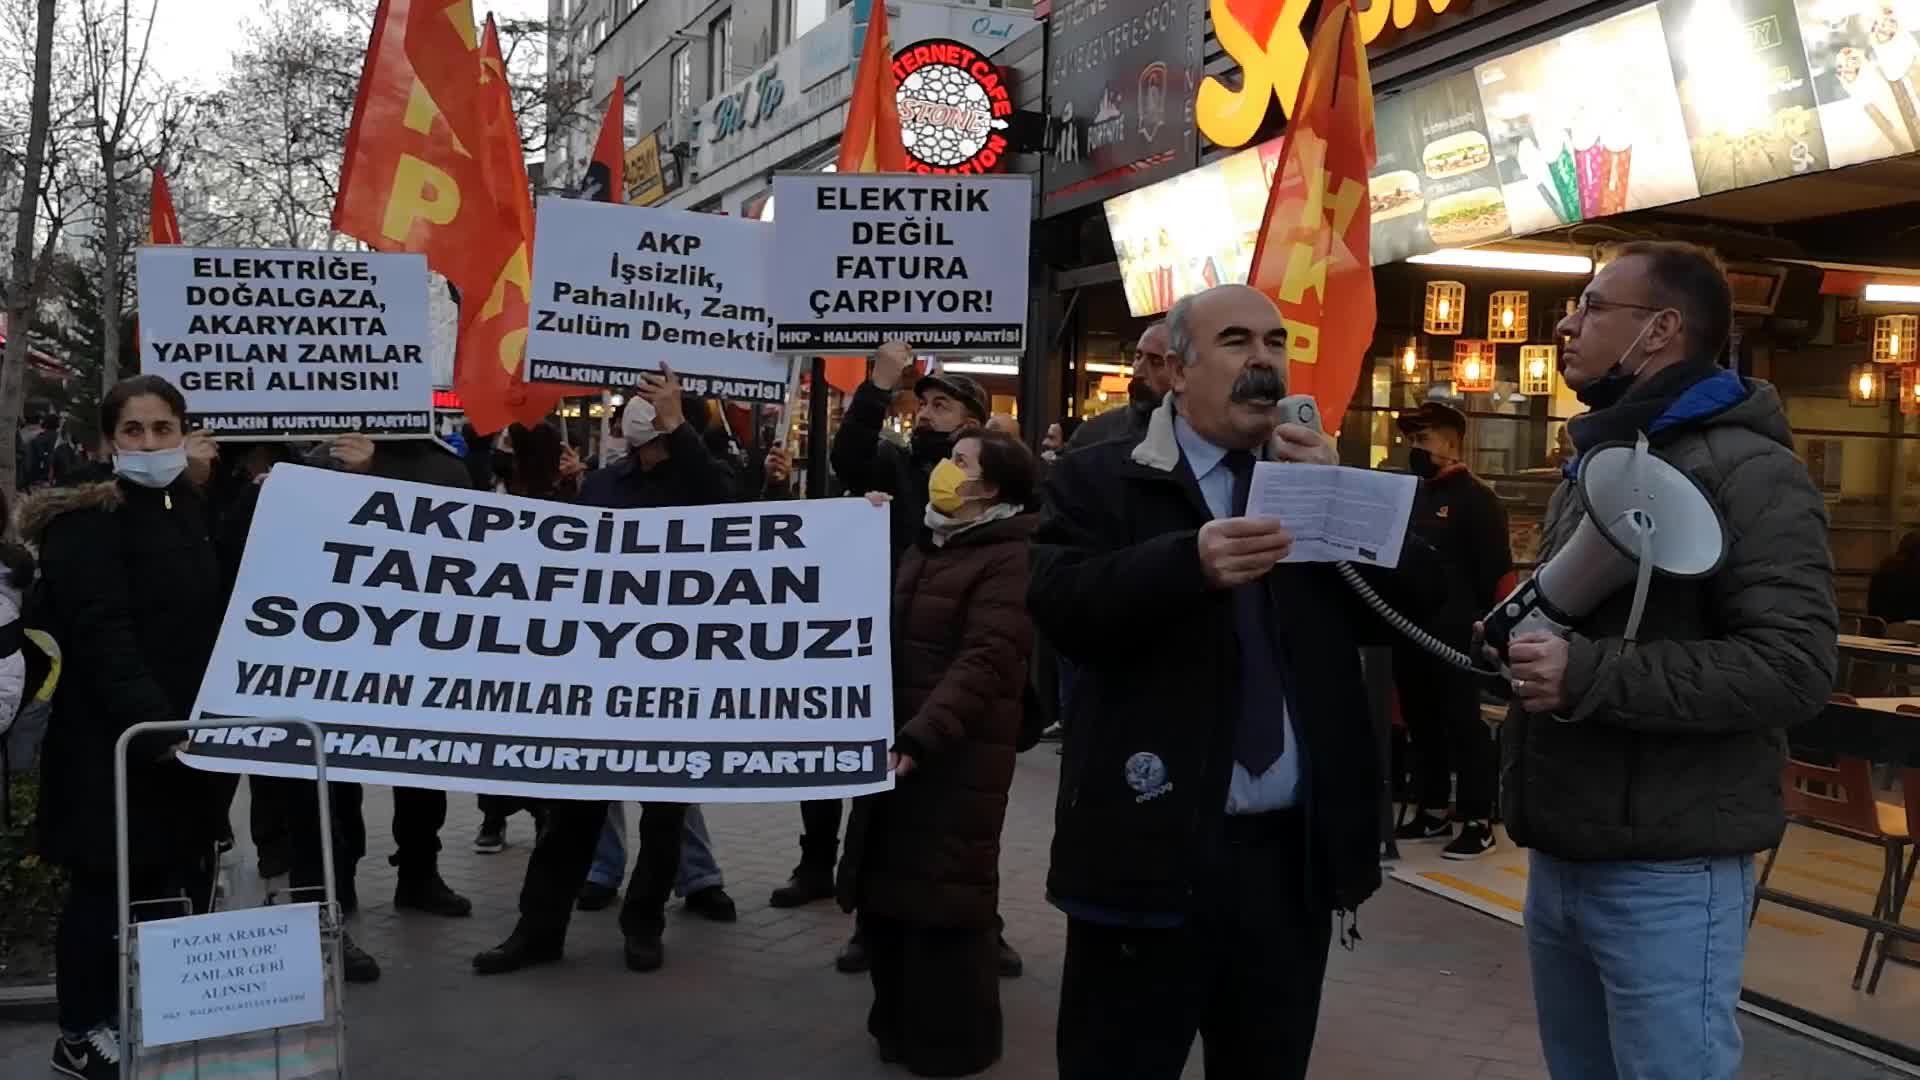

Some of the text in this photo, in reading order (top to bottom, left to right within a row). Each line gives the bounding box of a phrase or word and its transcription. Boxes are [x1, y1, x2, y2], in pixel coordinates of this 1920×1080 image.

[892, 44, 976, 87] TERNET
[971, 61, 1012, 117] CAFE
[899, 98, 991, 133] STONE
[816, 184, 989, 212] ELEKTRİK
[637, 231, 701, 257] AKP
[852, 217, 953, 246] DEĞİL
[193, 256, 377, 285] ELEKTRİĞE,
[610, 252, 723, 292] İşsizlik,
[836, 255, 968, 280] FATURA
[186, 283, 386, 312] DOĞALGAZA,
[552, 281, 774, 328] Pahalılık, Zam,
[809, 289, 993, 319] ÇARPIYOR!
[188, 315, 387, 336] AKARYAKITA
[536, 310, 631, 341] Zulüm
[779, 331, 812, 344] HKP
[823, 330, 879, 344] HALKIN
[883, 329, 961, 345] KURTULUŞ
[965, 327, 1020, 343] PARTİSİ
[152, 343, 423, 364] YAPILAN ZAMLAR
[180, 367, 399, 391] GERİ ALINSIN!
[534, 364, 780, 400] HALKIN KUUŞ PARTİSİ
[203, 416, 269, 430] HALKIN
[272, 416, 362, 431] KURTULUŞ
[366, 413, 427, 428] PARTİSİ
[321, 542, 821, 606] TARAFINDAN
[244, 596, 873, 661] SOYULUYORUZ!
[234, 660, 413, 707] YAPILAN
[422, 676, 593, 716] ZAMLAR
[709, 684, 872, 721] ALINSIN
[194, 726, 288, 748] HKP
[323, 730, 482, 766] HALKIN
[492, 745, 712, 779] KURTULUŞ
[722, 745, 873, 774] PARTİSİ
[172, 932, 221, 949] PAZAR
[186, 944, 277, 966] DOLMUYOR!
[181, 965, 245, 984] ZAMLAR
